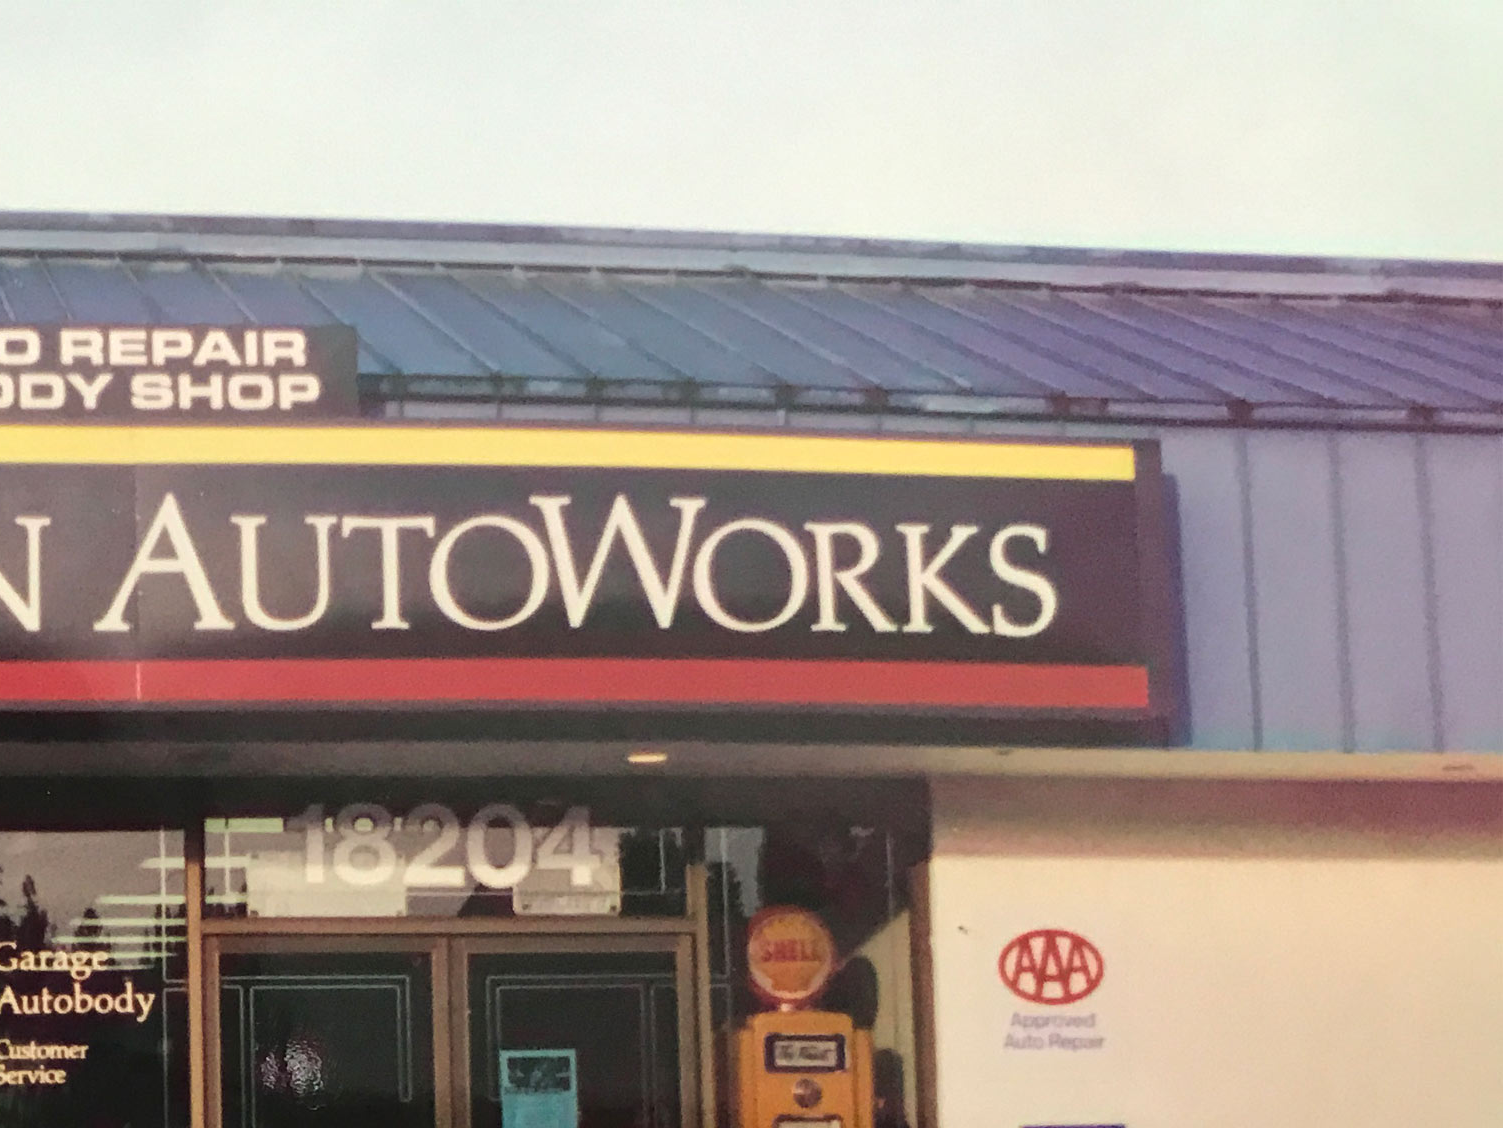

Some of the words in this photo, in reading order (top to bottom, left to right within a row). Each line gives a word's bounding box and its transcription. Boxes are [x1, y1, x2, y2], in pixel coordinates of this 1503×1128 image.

[58, 329, 307, 367] REPAIR
[130, 374, 321, 411] SHOP
[93, 492, 1058, 637] AUTOWORKS
[286, 803, 602, 888] 18204
[1011, 933, 1097, 1002] AAA
